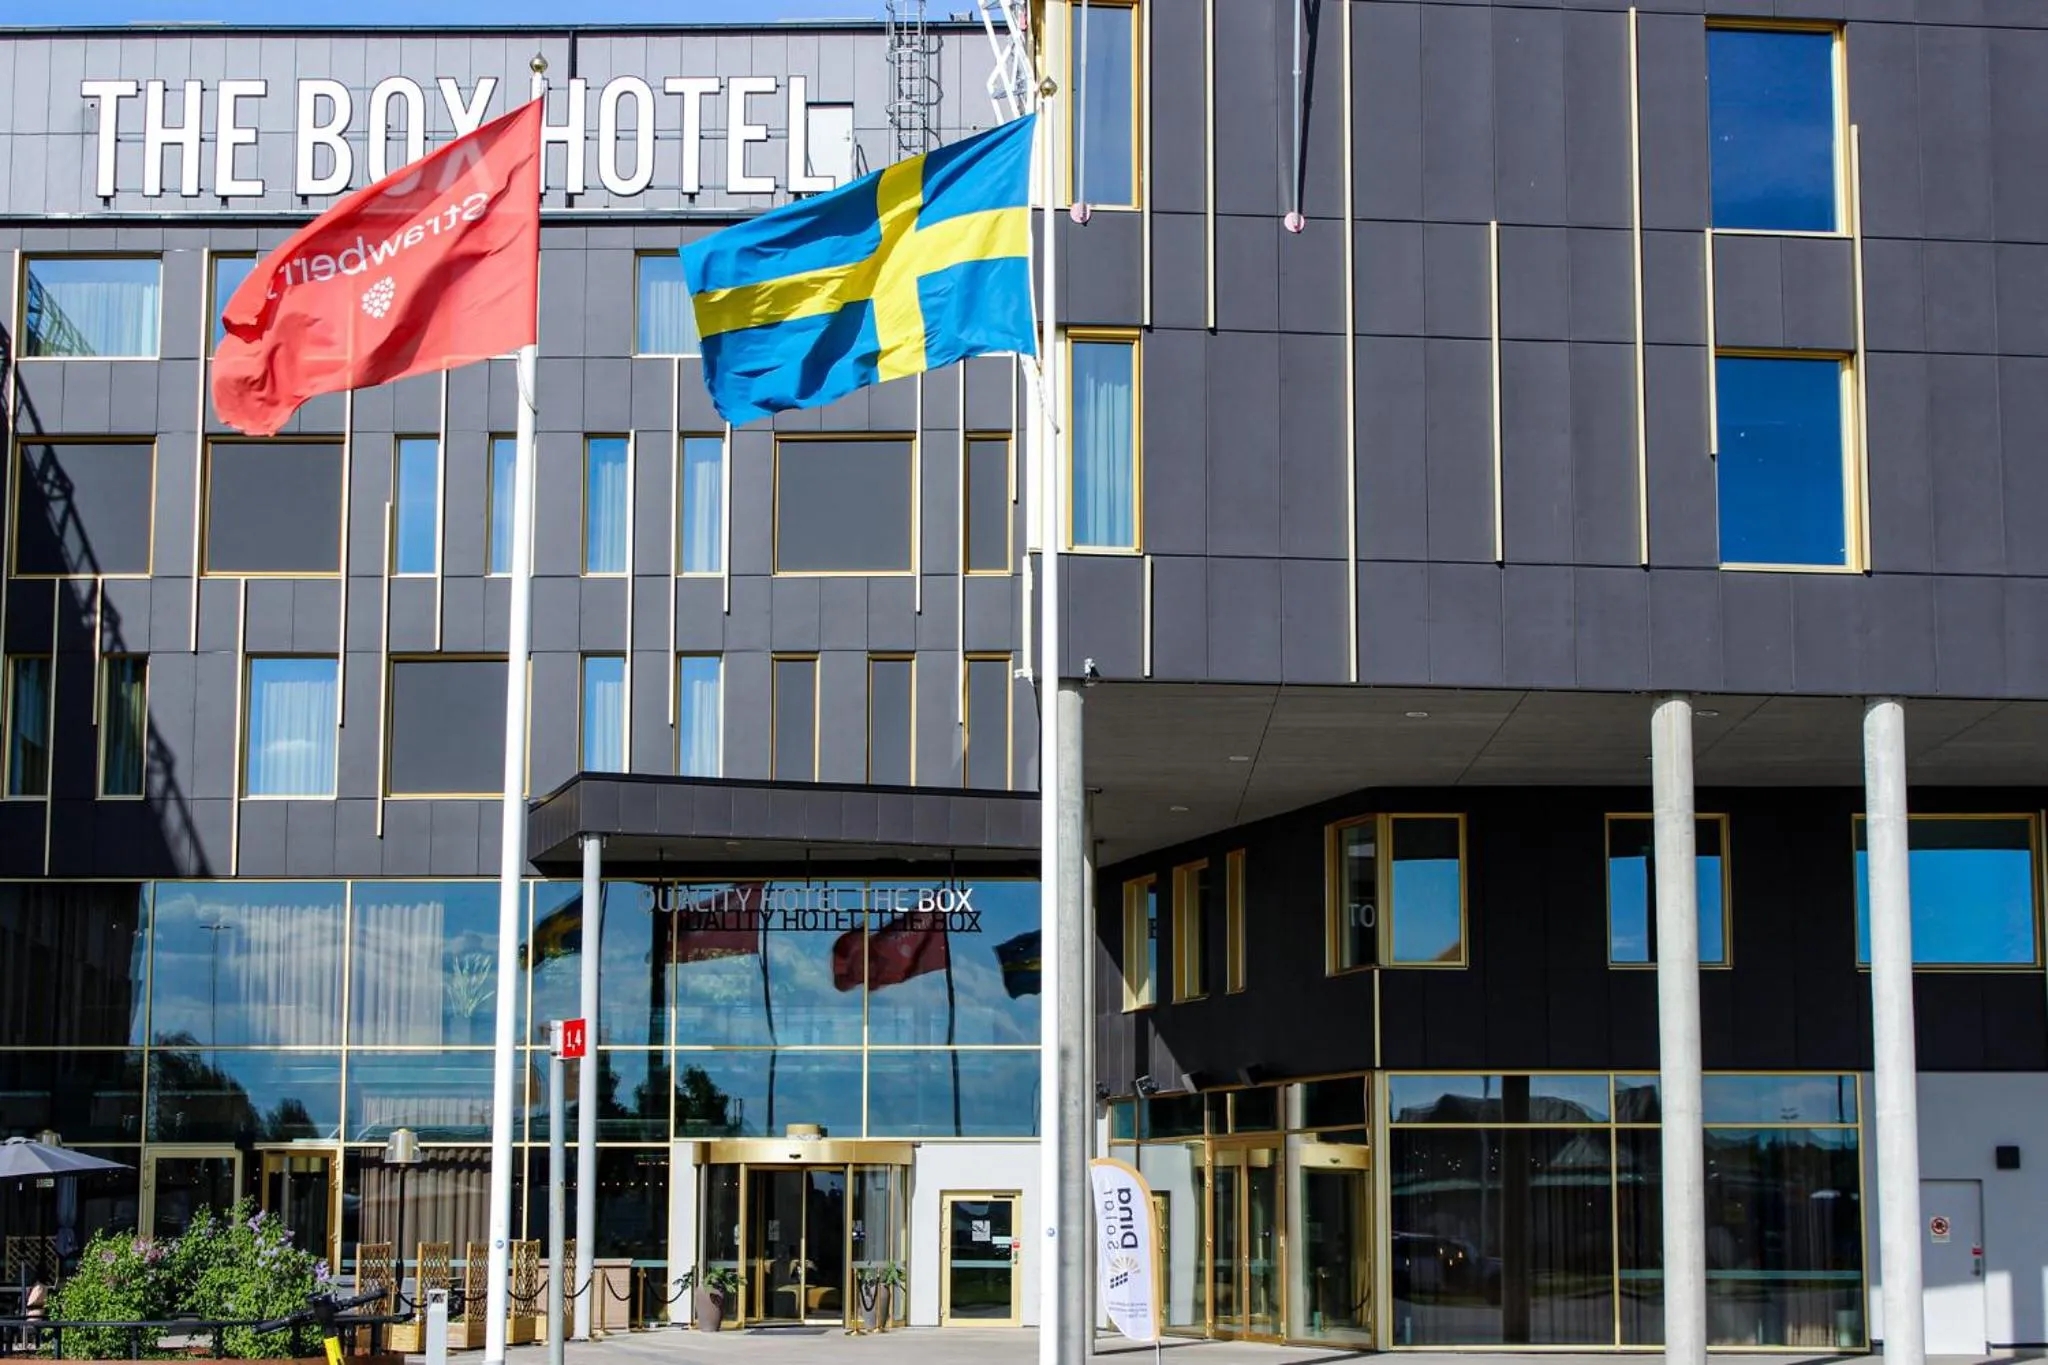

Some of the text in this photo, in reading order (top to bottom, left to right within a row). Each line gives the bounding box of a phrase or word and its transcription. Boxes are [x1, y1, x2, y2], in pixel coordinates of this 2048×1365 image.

[80, 75, 836, 198] THE BOX HOTEL
[637, 886, 974, 914] QUALITY HOTEL THE BOX
[566, 1029, 582, 1052] 1,4
